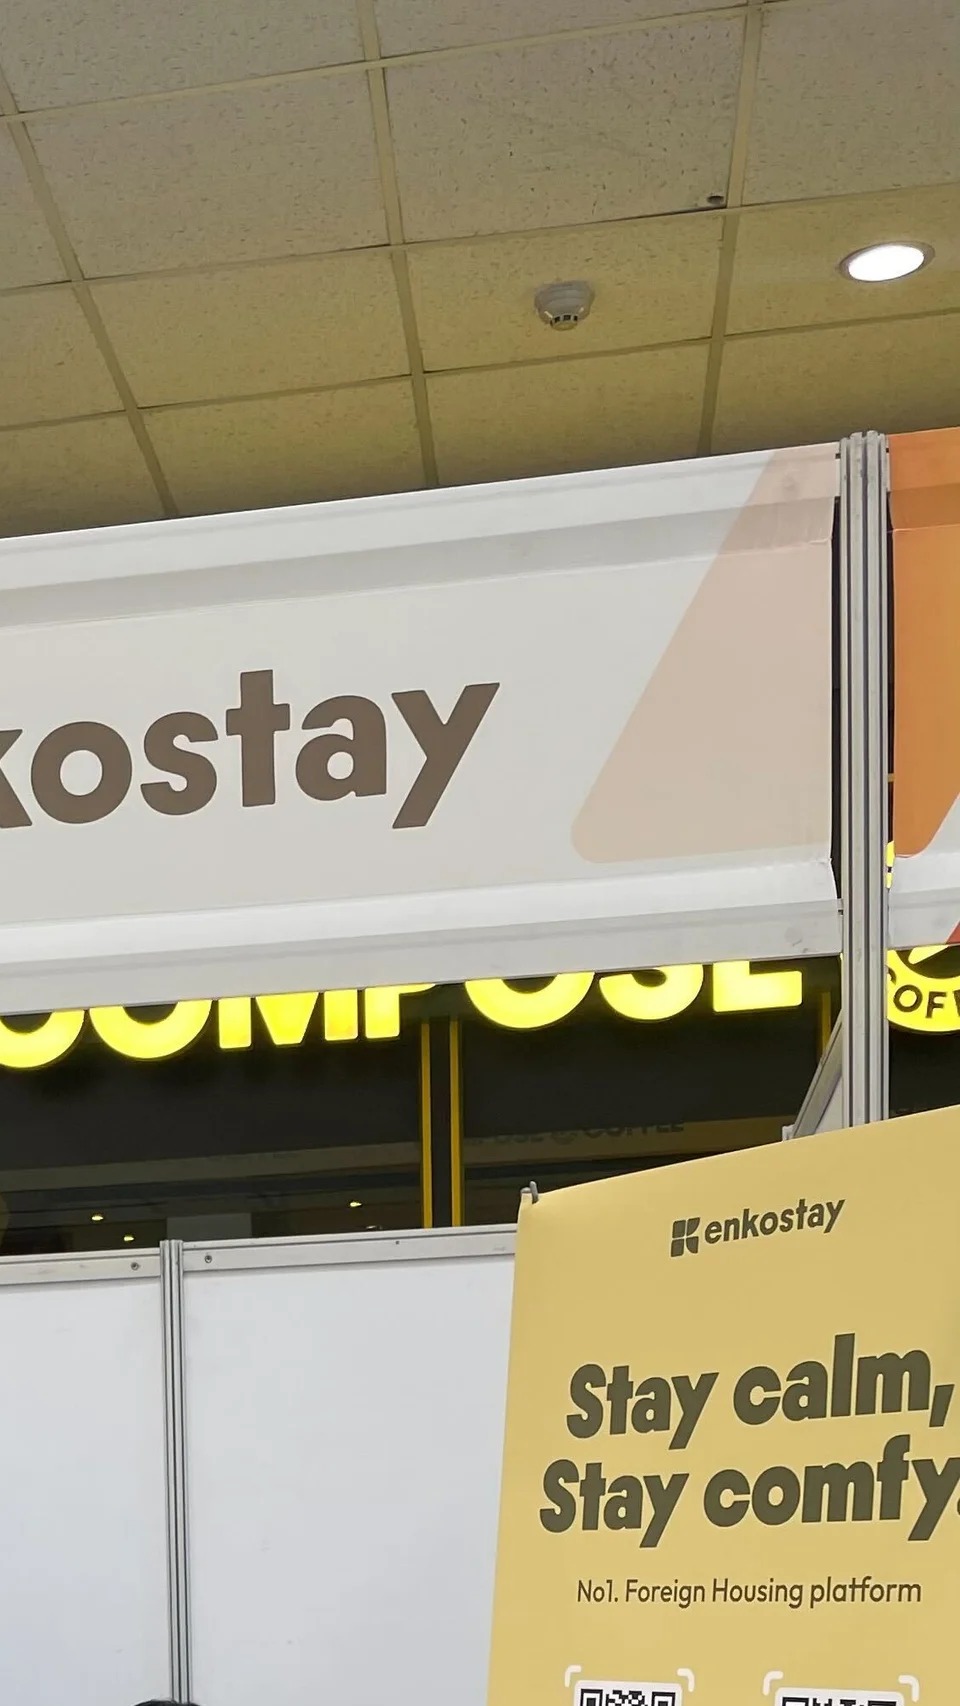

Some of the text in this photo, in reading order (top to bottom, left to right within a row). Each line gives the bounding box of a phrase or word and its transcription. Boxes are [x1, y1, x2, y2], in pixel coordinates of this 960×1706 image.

[704, 1198, 846, 1245] enkostay
[566, 1332, 956, 1451] Stay calm,
[539, 1433, 960, 1549] Stay comfy
[577, 1575, 922, 1610] No1. Foreign Housing platform
